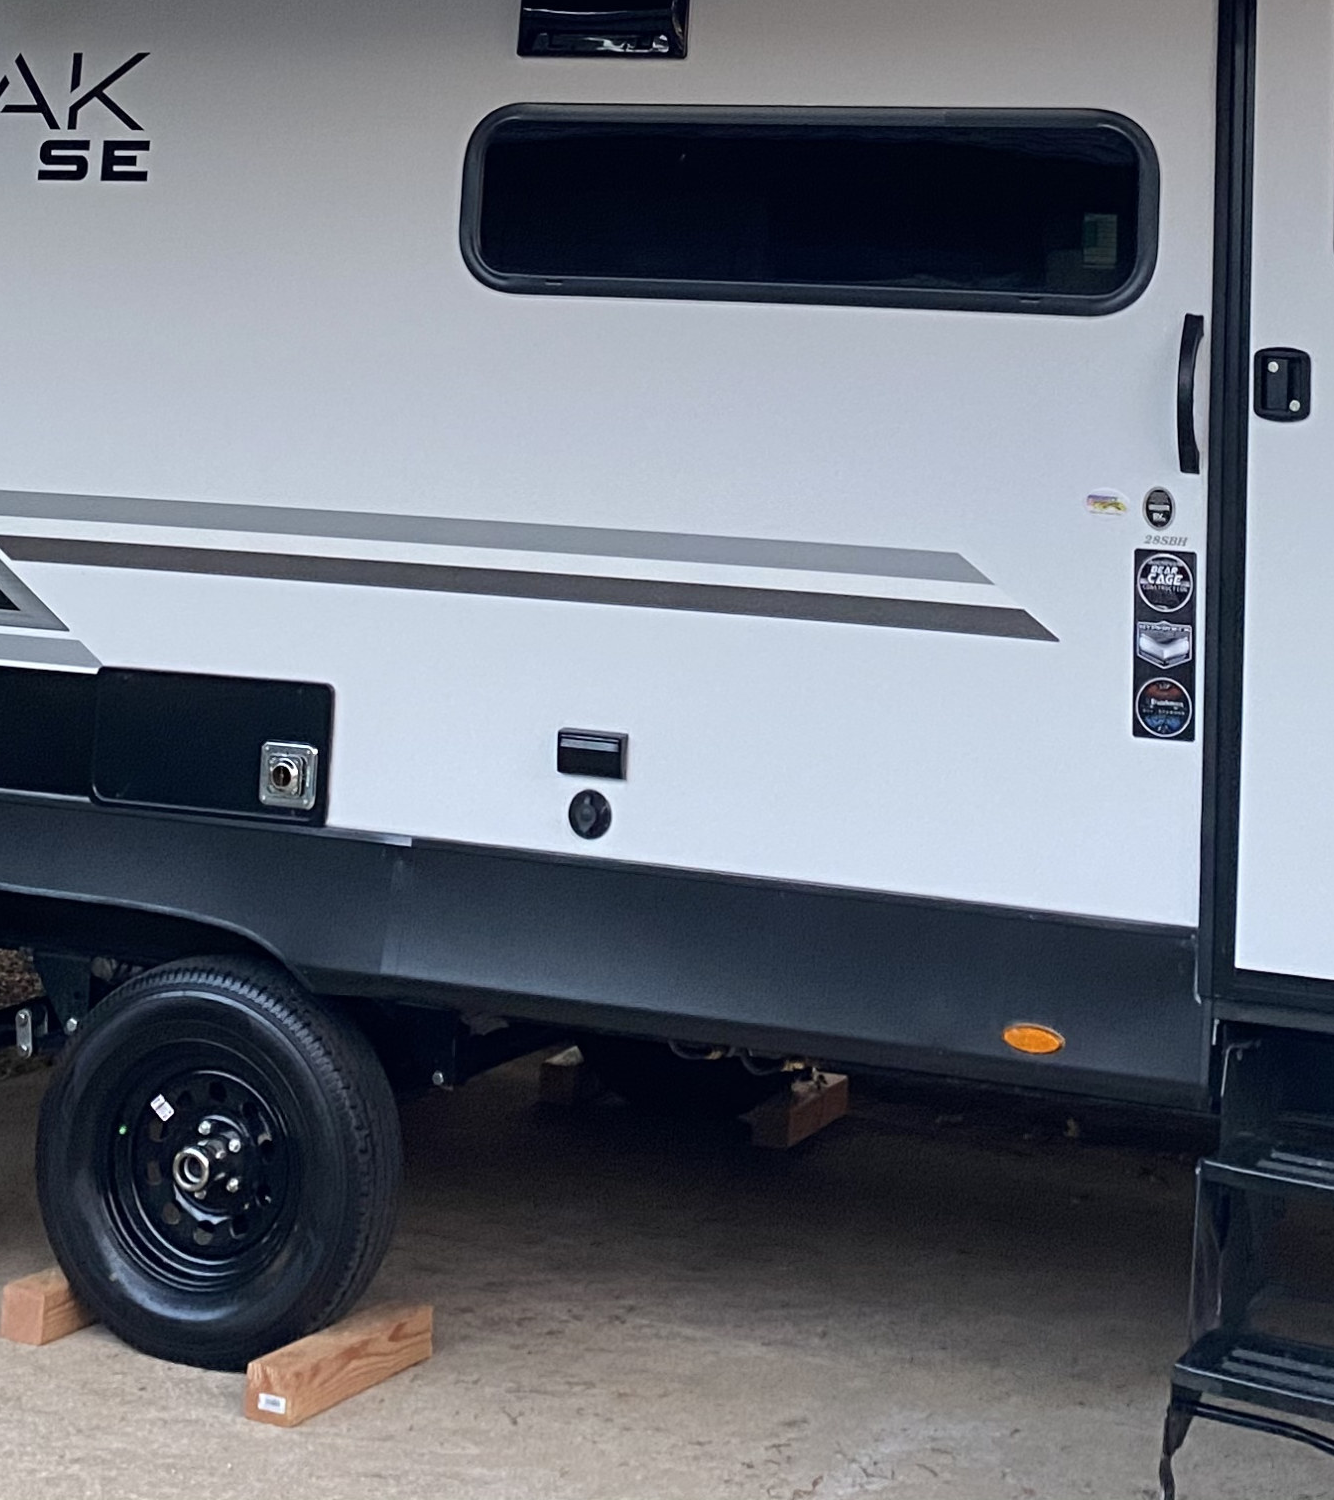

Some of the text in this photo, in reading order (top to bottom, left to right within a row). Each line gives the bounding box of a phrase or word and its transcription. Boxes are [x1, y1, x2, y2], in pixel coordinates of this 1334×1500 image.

[37, 139, 151, 182] SE
[1143, 534, 1189, 547] 28SBH
[1150, 565, 1178, 575] BEAR
[1147, 573, 1184, 586] CAGE
